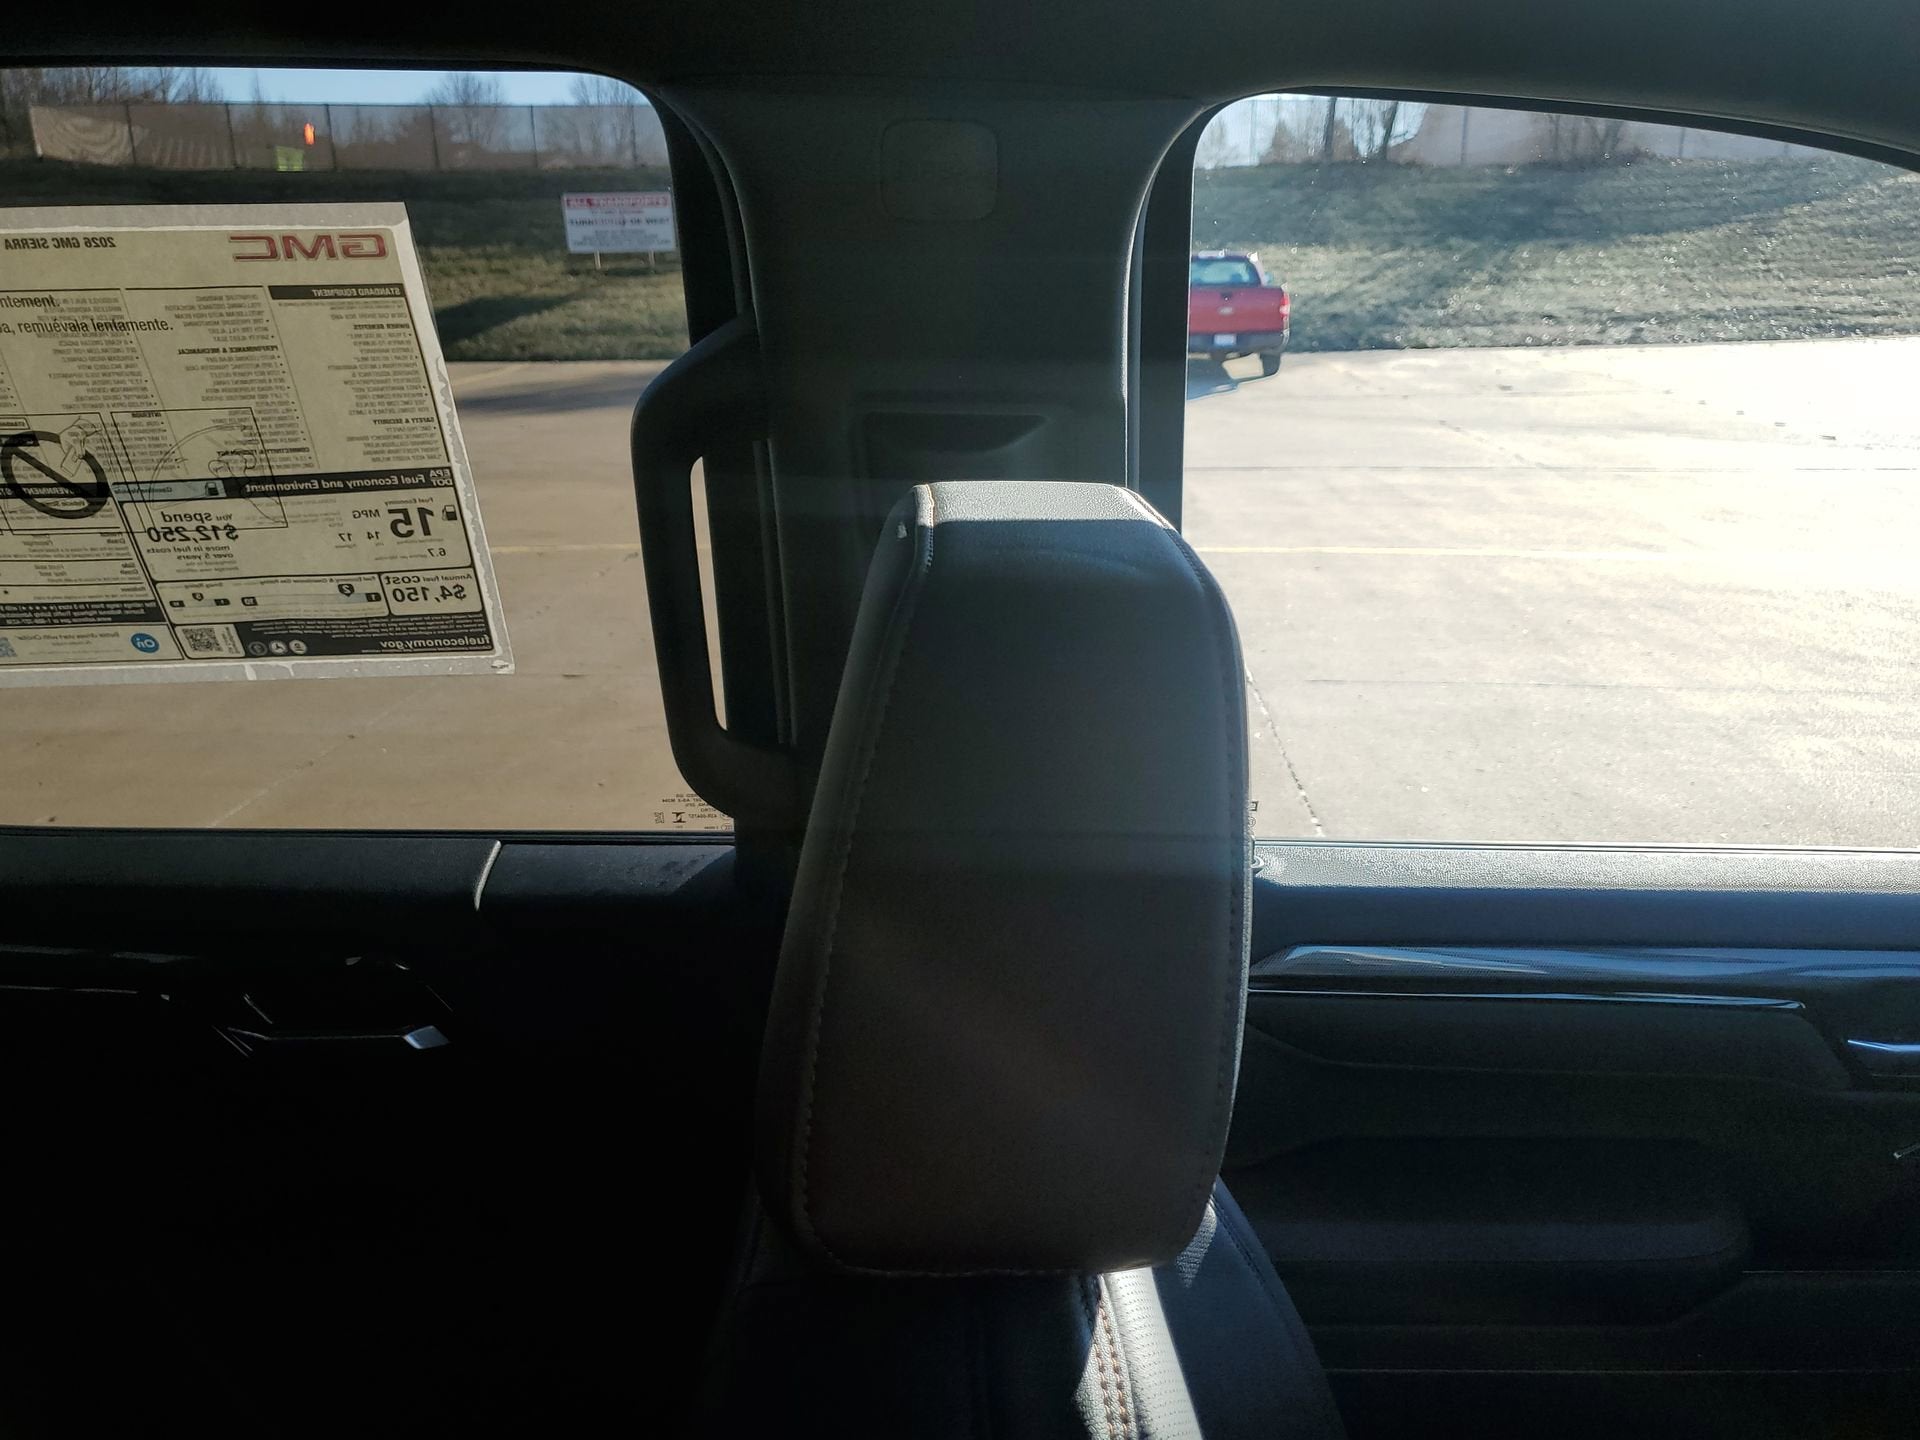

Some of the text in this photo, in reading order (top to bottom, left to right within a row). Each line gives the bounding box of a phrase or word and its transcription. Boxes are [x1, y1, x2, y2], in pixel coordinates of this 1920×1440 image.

[0, 318, 174, 336] a, remuévala lentamente.
